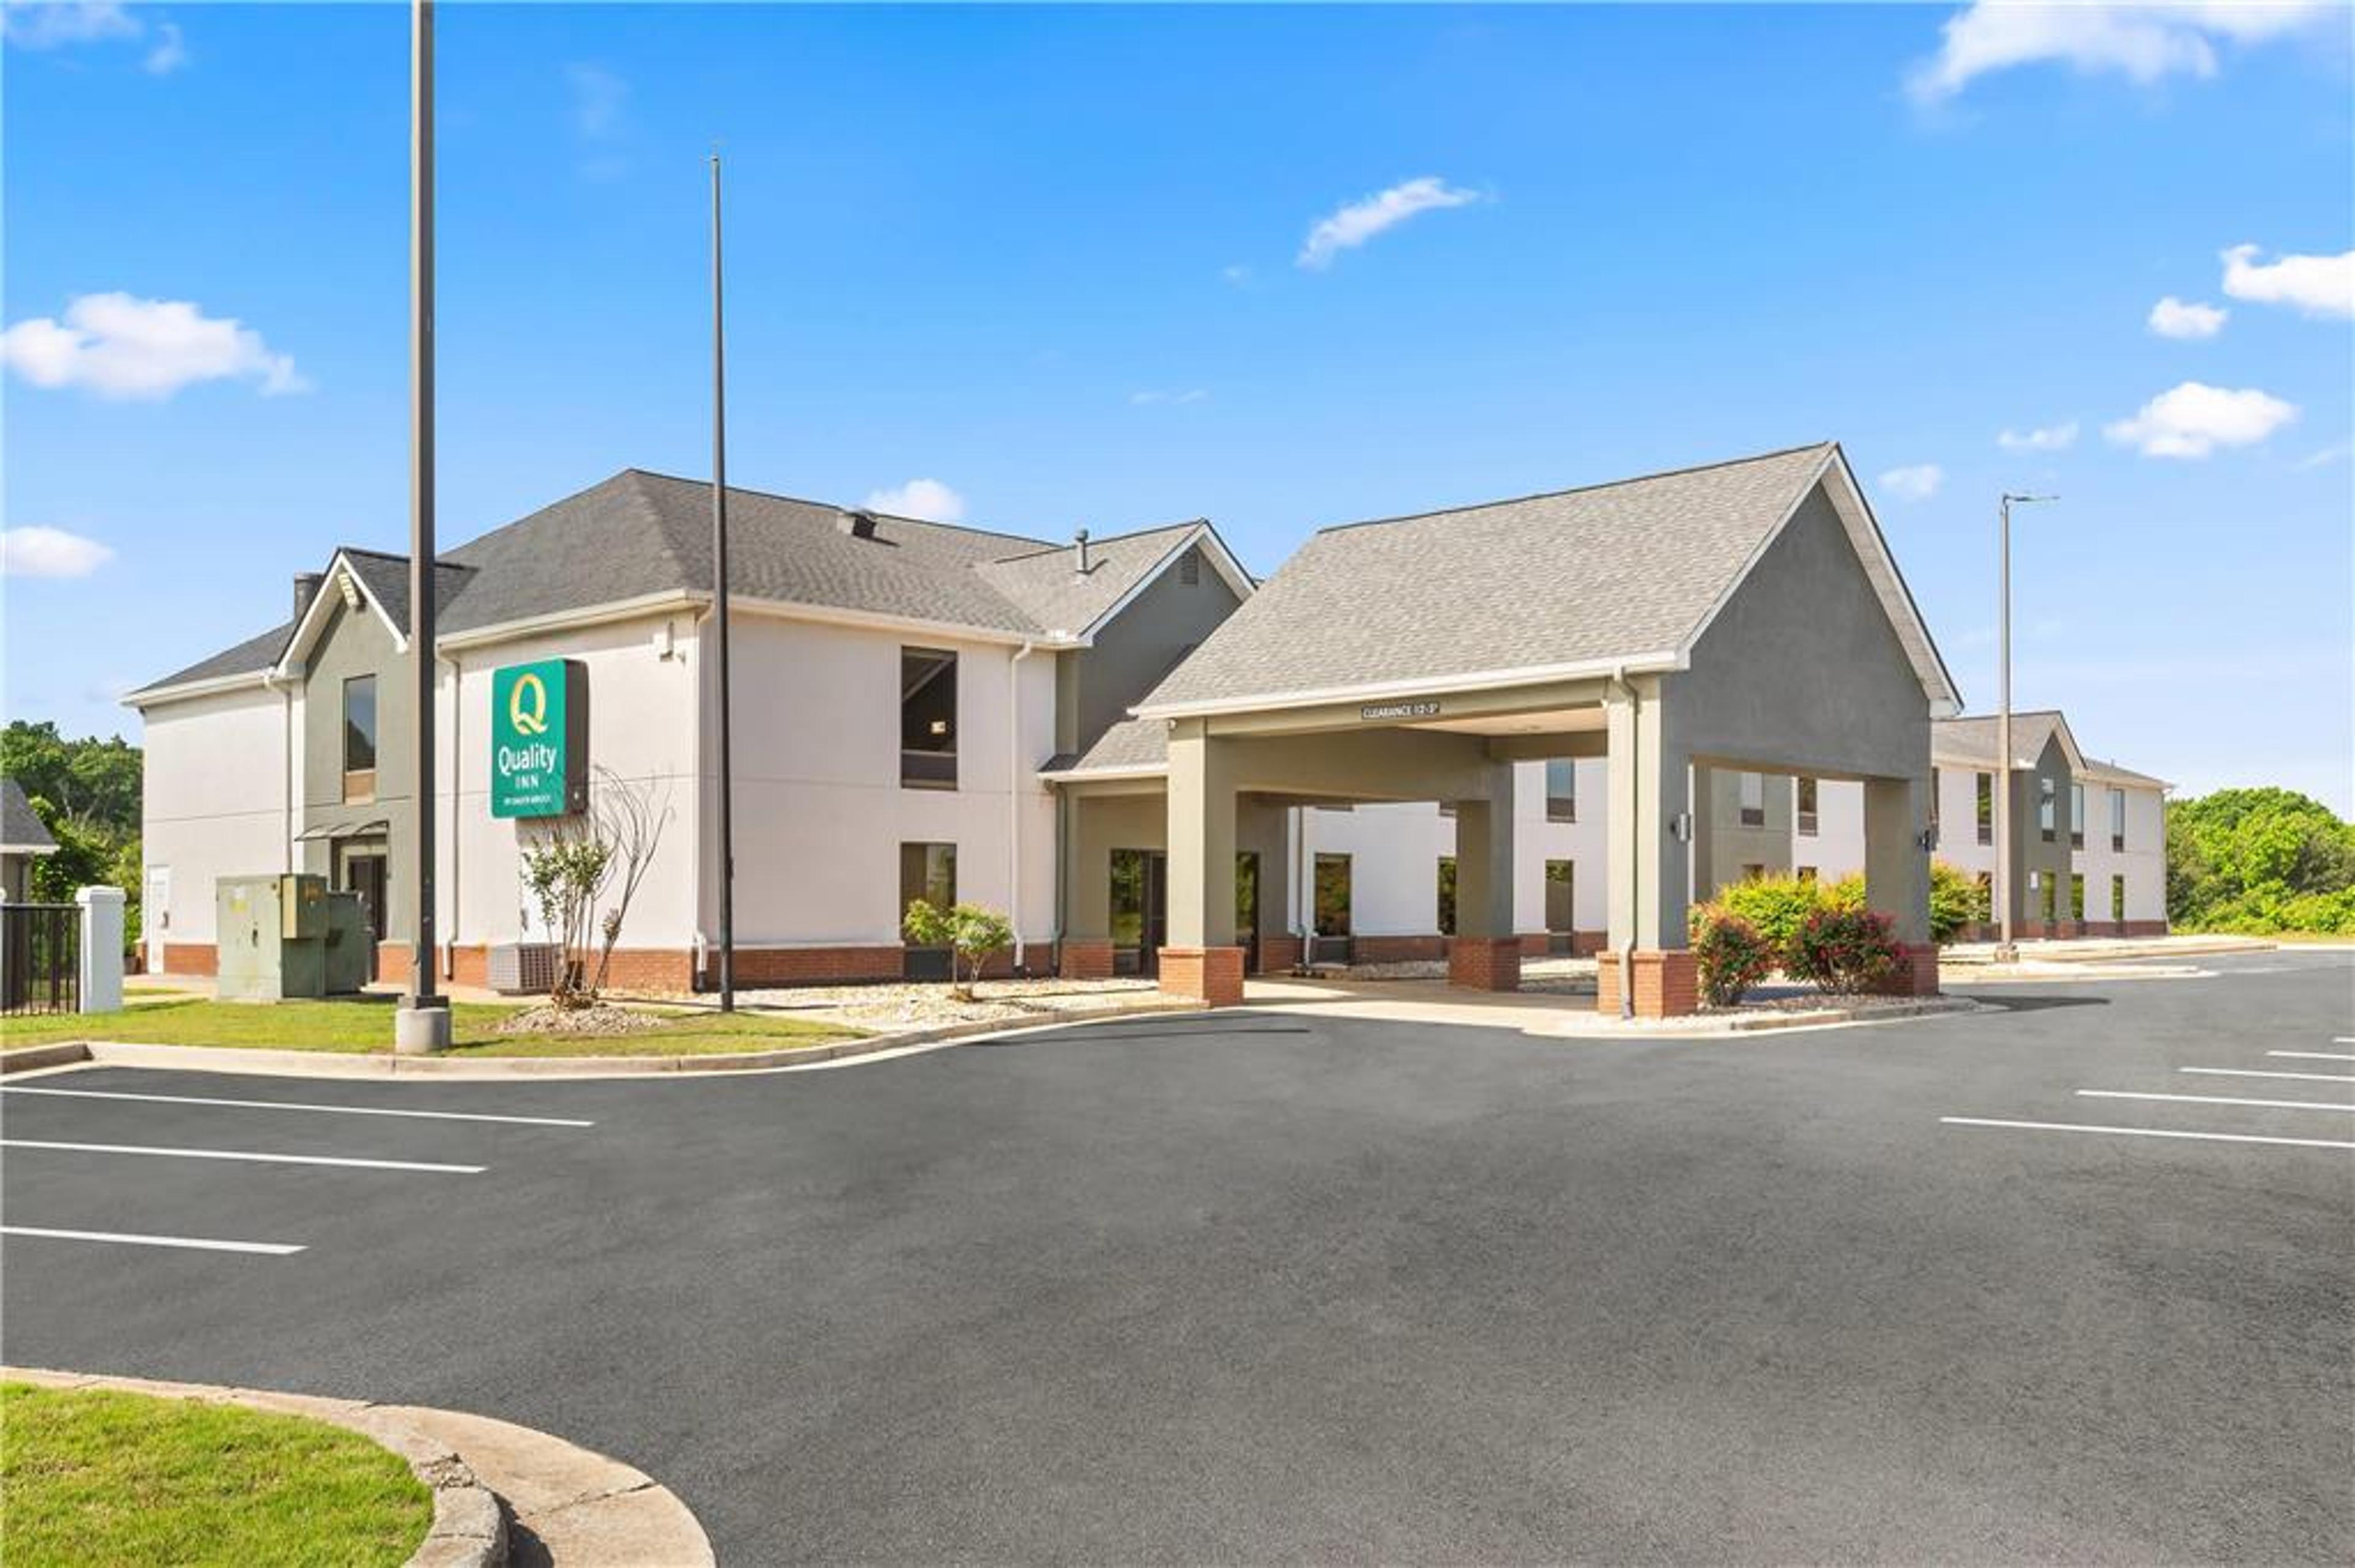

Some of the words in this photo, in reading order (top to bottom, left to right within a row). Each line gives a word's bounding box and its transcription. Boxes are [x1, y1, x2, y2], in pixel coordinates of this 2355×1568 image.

[510, 673, 548, 735] Q
[1363, 705, 1411, 718] CLEARANCE
[498, 743, 556, 776] Quality
[515, 774, 539, 789] INN
